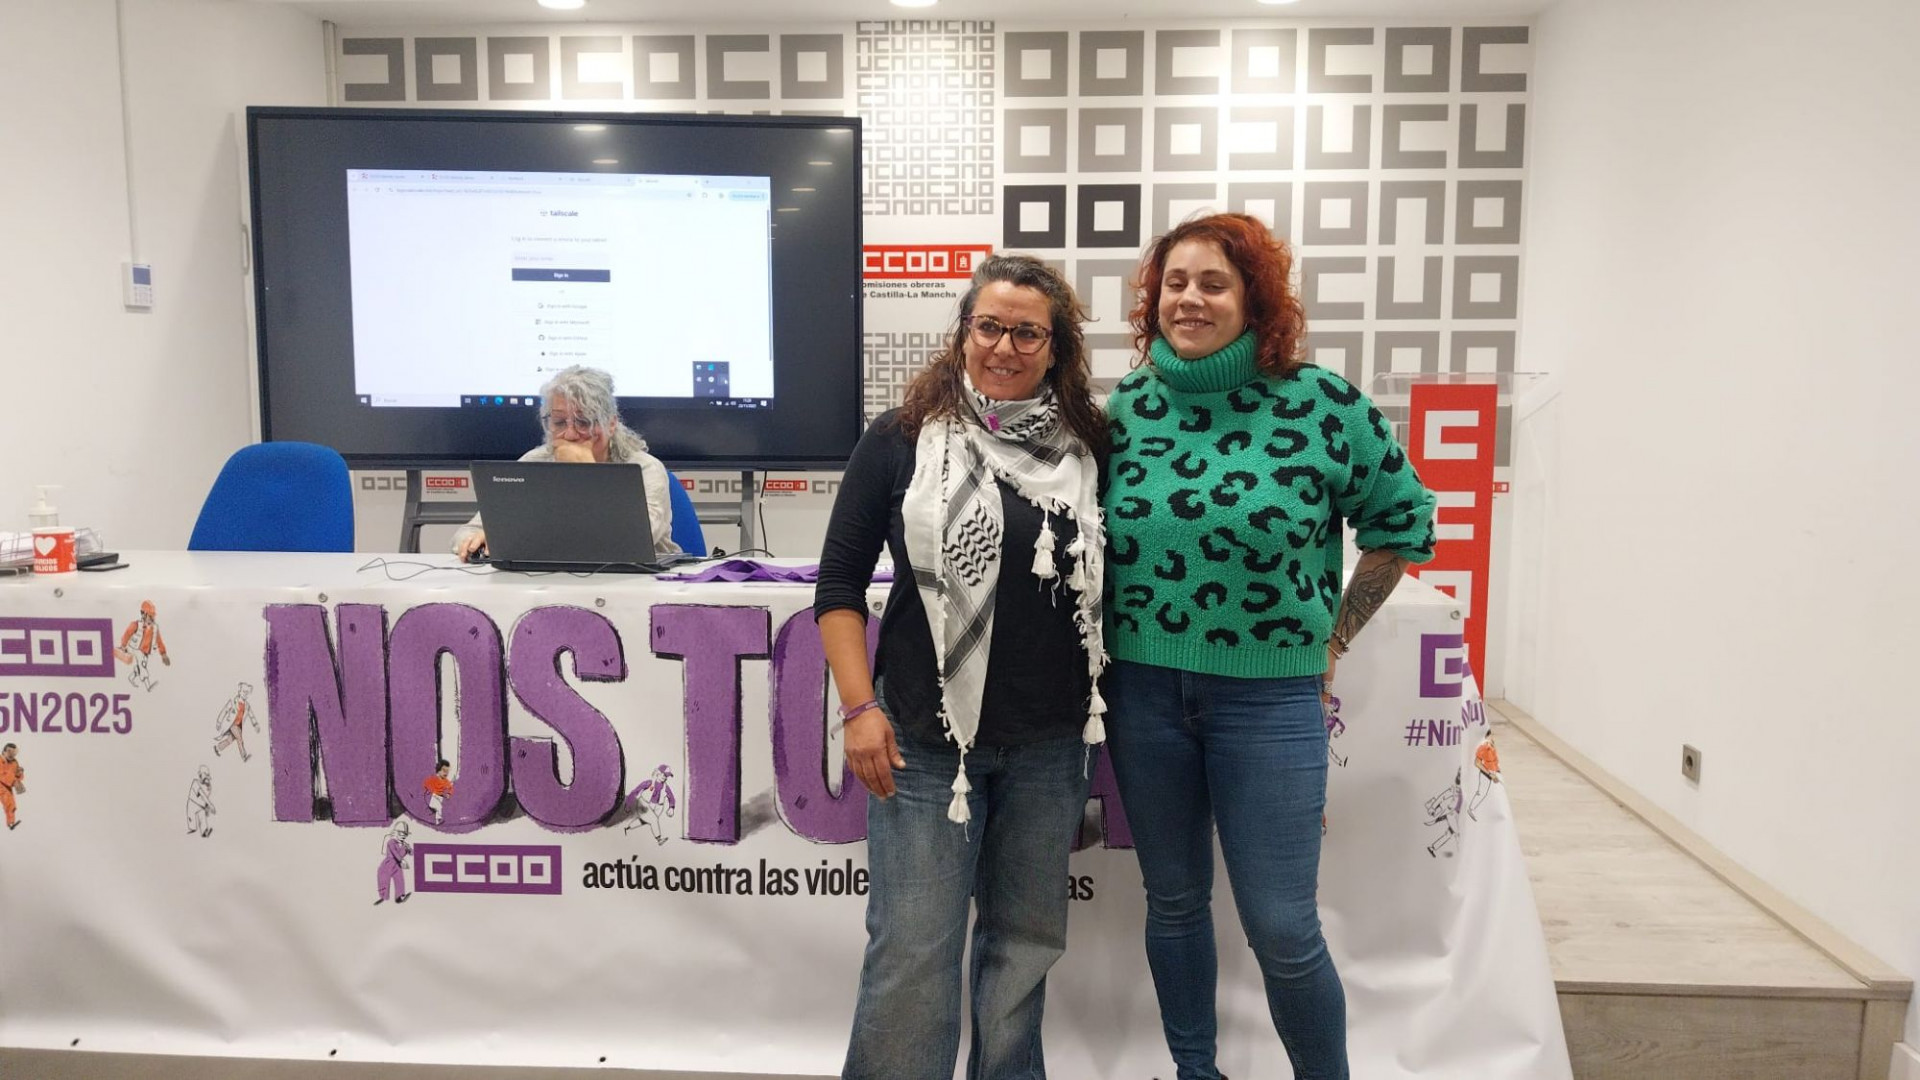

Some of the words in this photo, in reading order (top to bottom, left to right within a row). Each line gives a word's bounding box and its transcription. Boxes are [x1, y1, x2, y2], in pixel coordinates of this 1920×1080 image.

[863, 251, 949, 272] CCOO
[862, 281, 908, 289] omisiones
[910, 281, 946, 289] obreras
[921, 290, 957, 299] Mancha
[264, 602, 628, 834] NOS
[424, 853, 552, 885] CCOO
[582, 855, 660, 890] actúa
[664, 863, 753, 895] contra
[759, 858, 799, 896] las
[804, 858, 870, 896] viole
